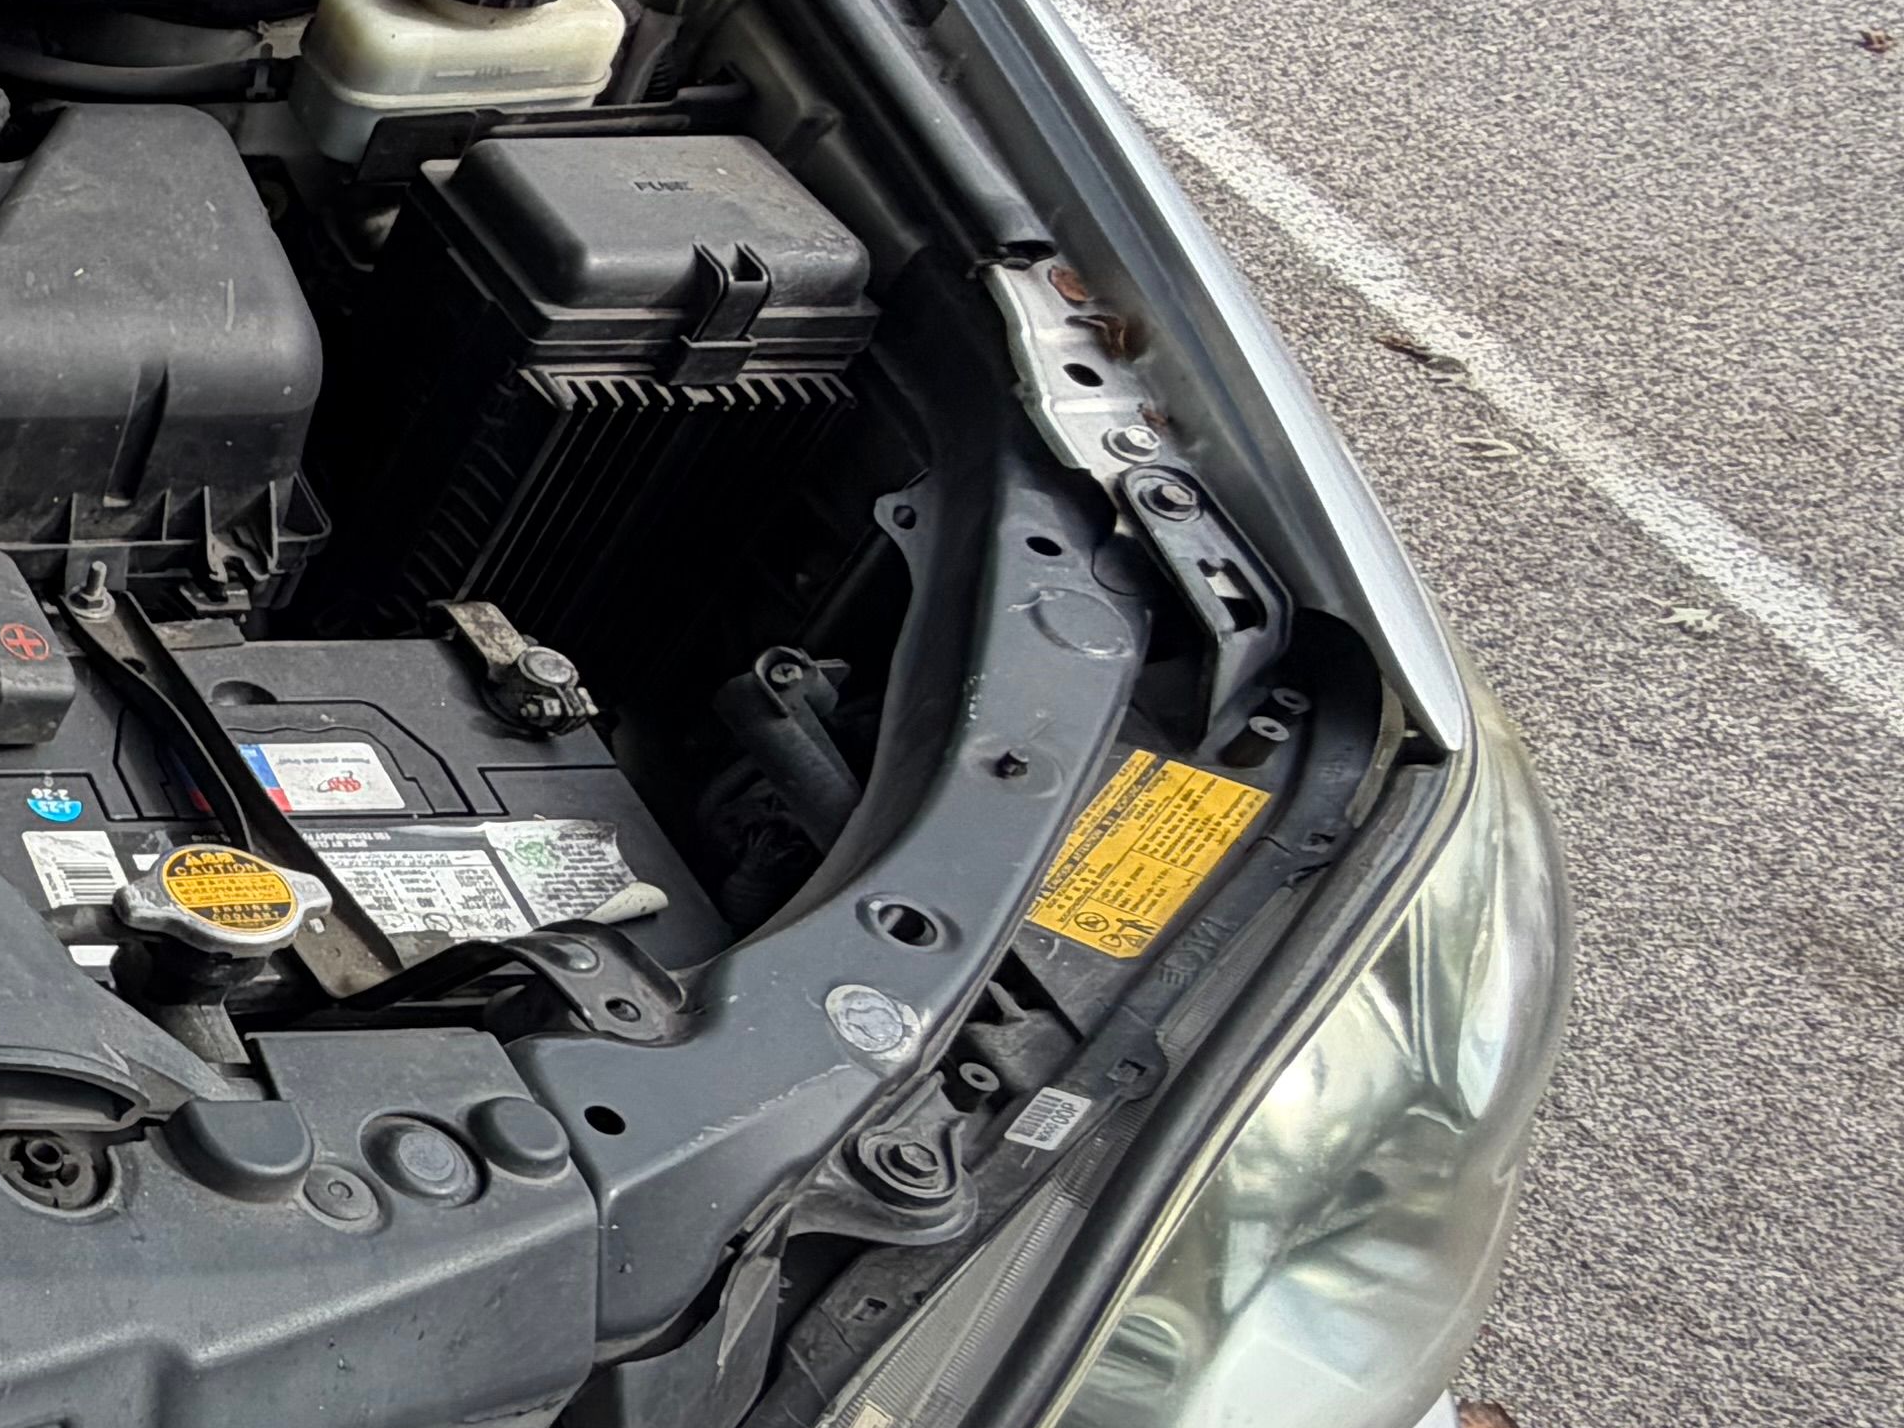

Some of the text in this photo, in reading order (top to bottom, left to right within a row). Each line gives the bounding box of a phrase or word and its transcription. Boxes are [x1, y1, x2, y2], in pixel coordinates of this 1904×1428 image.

[174, 863, 259, 875] CAUTION
[212, 904, 271, 912] ENGINE
[212, 911, 279, 920] COOLANT
